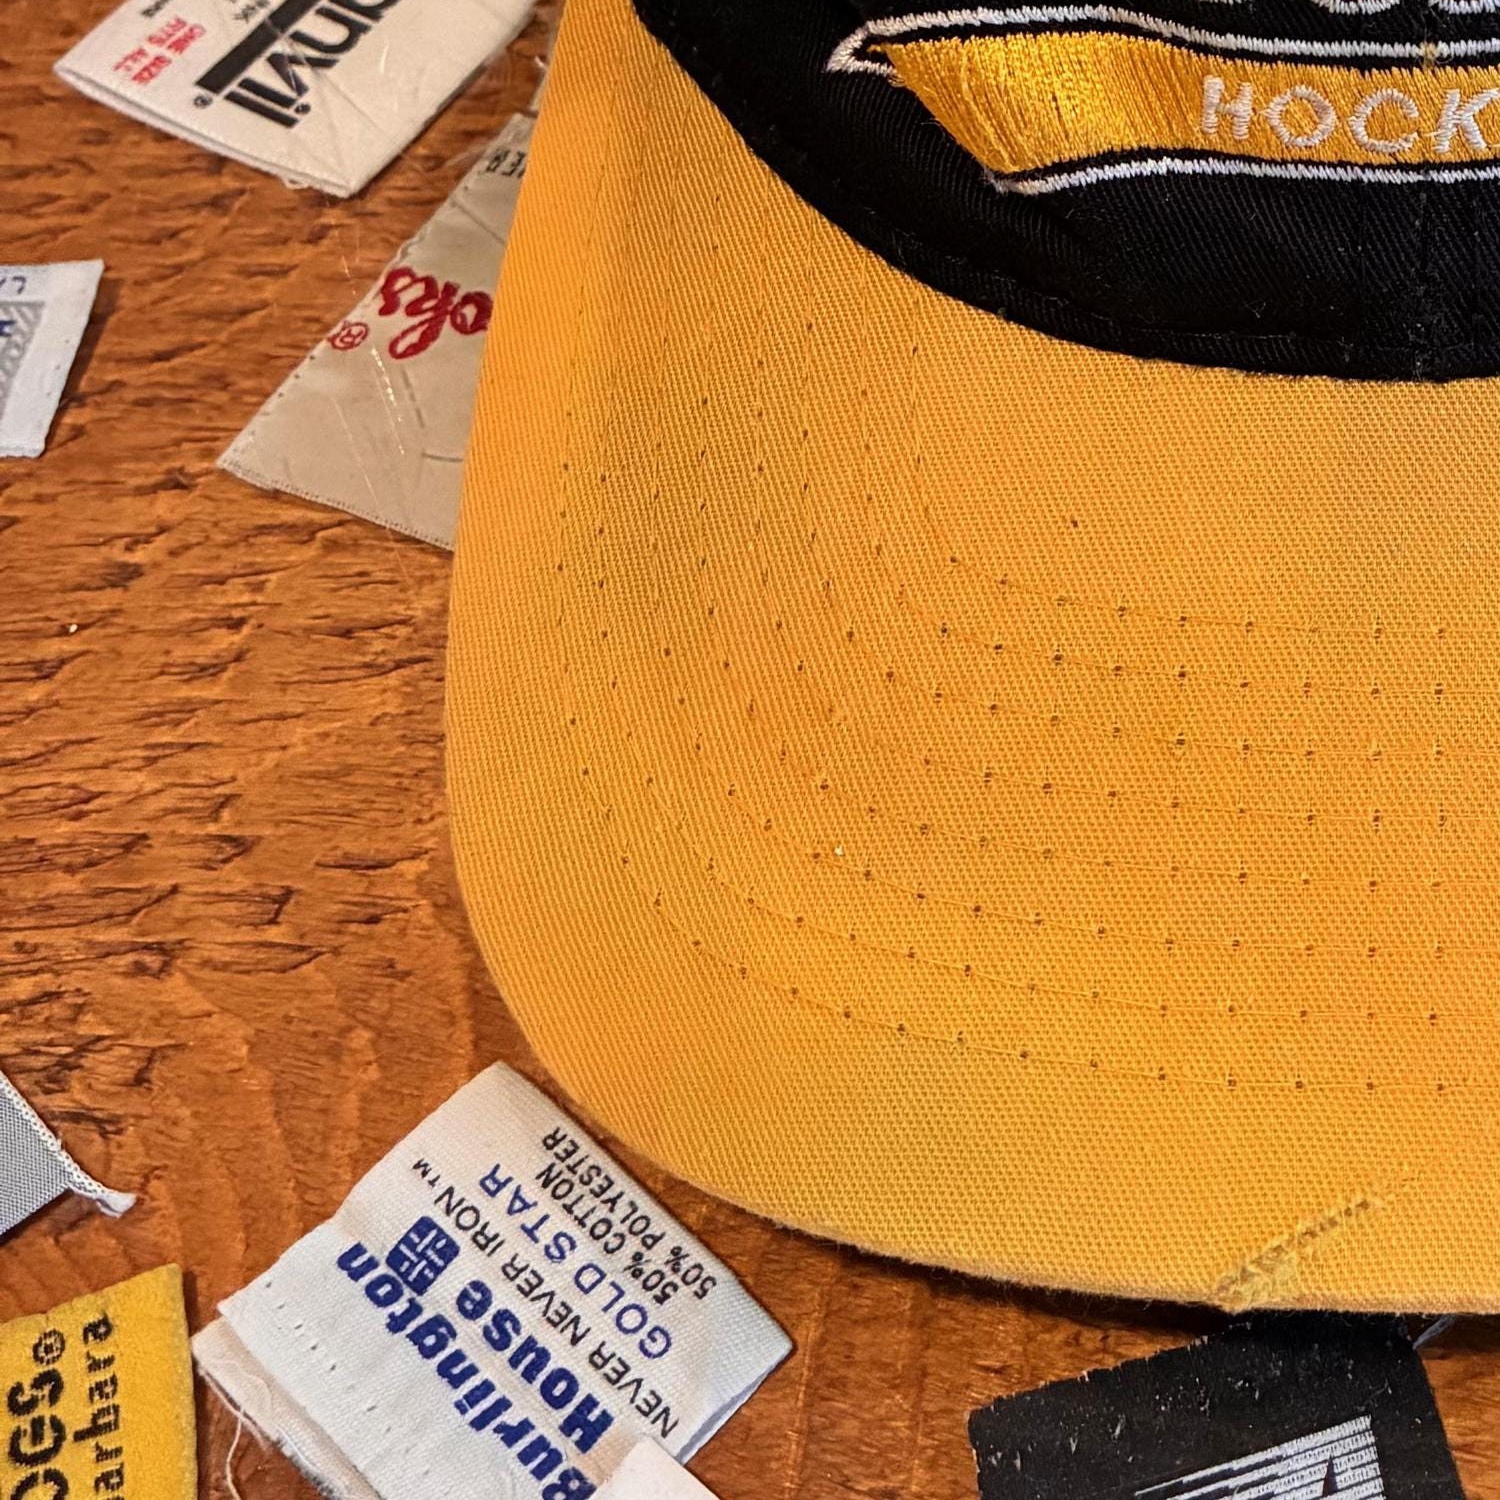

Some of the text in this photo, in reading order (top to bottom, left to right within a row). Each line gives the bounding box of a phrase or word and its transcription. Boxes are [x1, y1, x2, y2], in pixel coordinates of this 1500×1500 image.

[478, 1162, 673, 1360] GOLD STAR
[500, 1252, 593, 1348] NEVER
[536, 1160, 679, 1306] 50% COTTON
[541, 1126, 718, 1301] 50% POLYESTER
[335, 1240, 598, 1500] Burlington
[455, 1278, 616, 1455] House
[587, 1340, 680, 1440] NEVER
